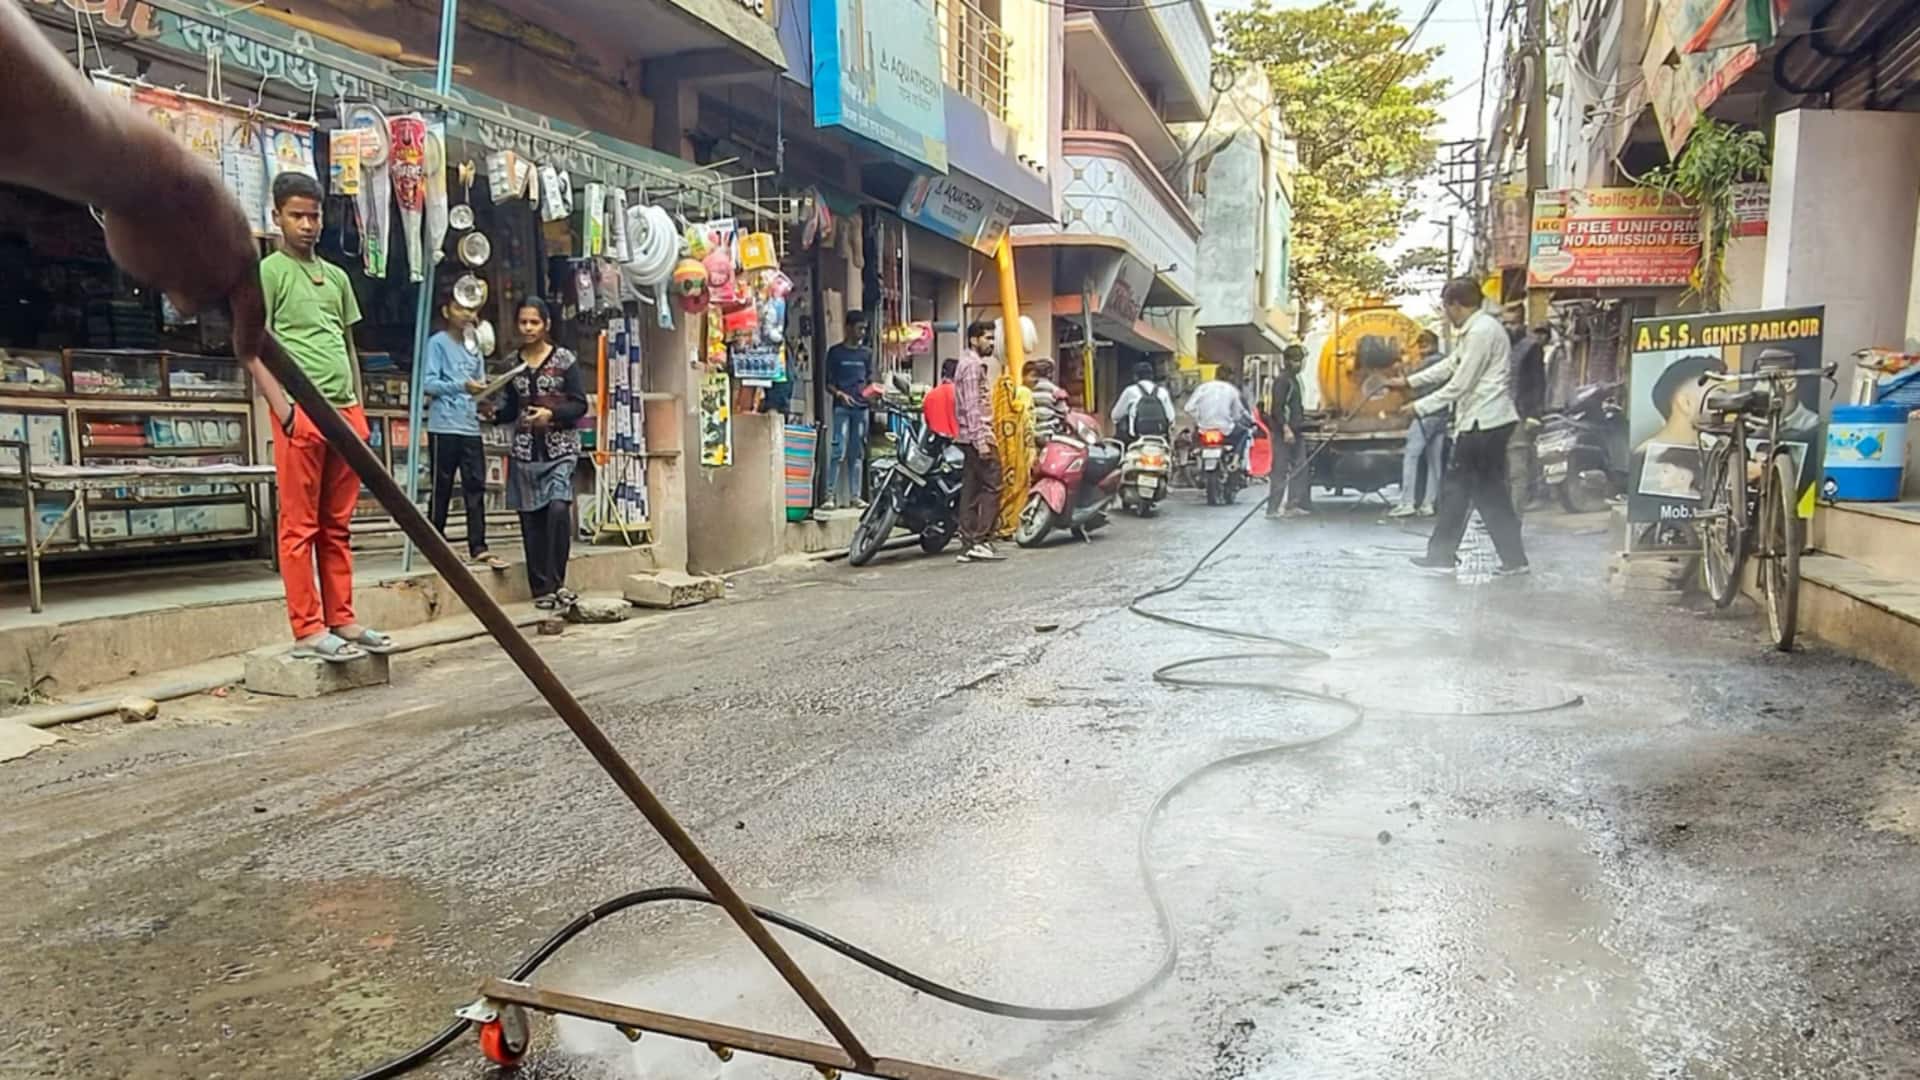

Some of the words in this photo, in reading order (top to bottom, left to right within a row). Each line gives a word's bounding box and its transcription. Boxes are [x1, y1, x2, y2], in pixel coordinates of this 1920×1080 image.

[1536, 220, 1560, 231] LKG
[1567, 220, 1612, 234] FREE
[1617, 219, 1698, 233] UNIFORM
[1563, 234, 1584, 247] NO
[1587, 233, 1668, 247] ADMISSION
[1637, 324, 1695, 350] A.S.S.
[1702, 324, 1747, 345] GENTS
[1750, 318, 1820, 342] PARLOUR
[1660, 503, 1693, 520] Mob.
